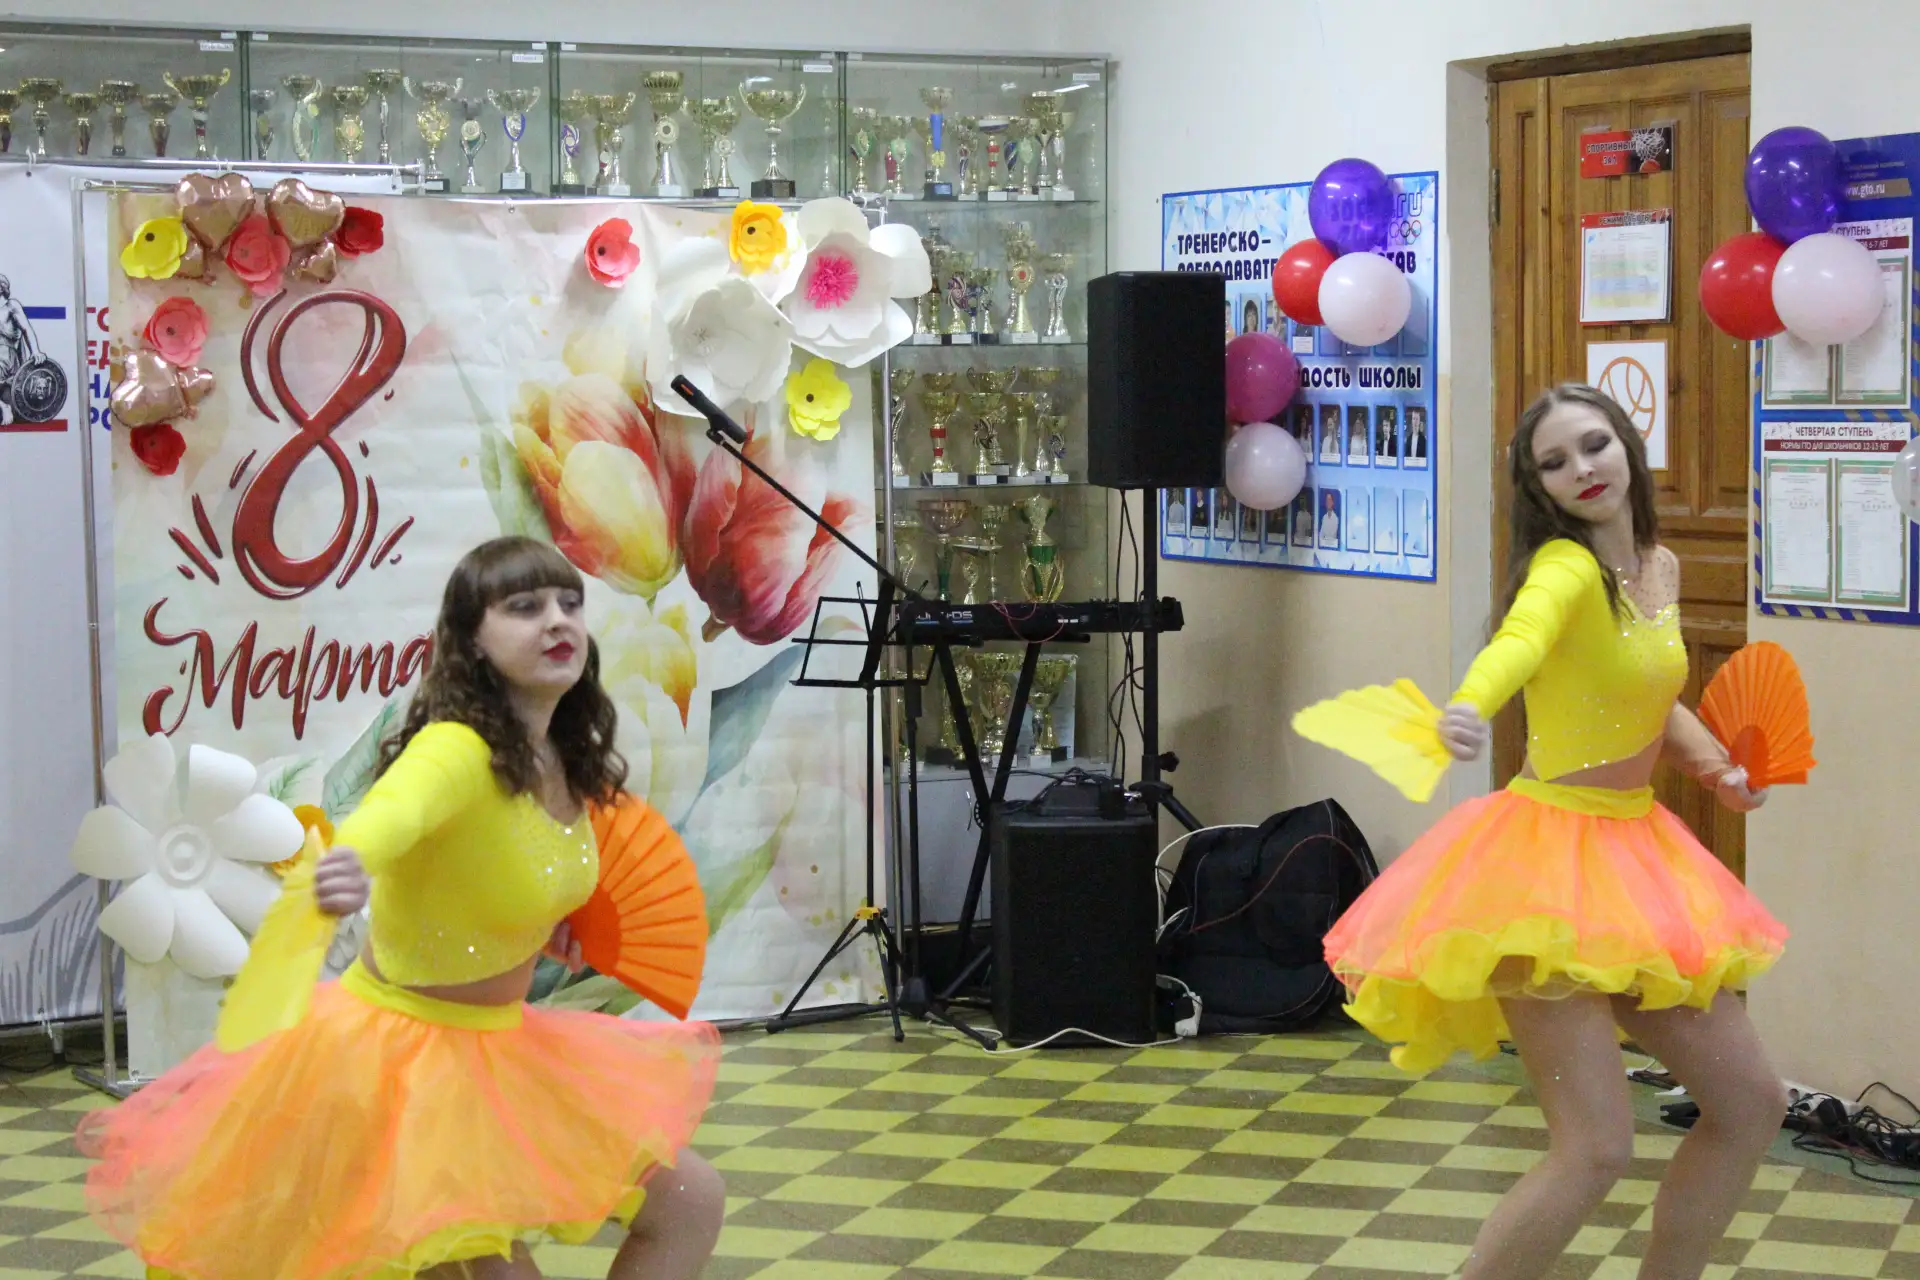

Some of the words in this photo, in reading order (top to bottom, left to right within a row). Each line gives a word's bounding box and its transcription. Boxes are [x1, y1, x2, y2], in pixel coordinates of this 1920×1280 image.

[1587, 140, 1637, 154] СПОРТИВНЫЙ
[1603, 154, 1617, 165] ЗАЛ
[1178, 230, 1271, 255] ТРЕНЕРСКО-
[1300, 366, 1351, 388] ДОСТЬ
[1359, 366, 1422, 388] ШКОЛЫ
[1795, 426, 1836, 437] ЧЕТВЕРТАЯ
[1838, 426, 1874, 437] СТУПЕНЬ
[233, 289, 406, 600] 8
[143, 597, 434, 741] Марта
